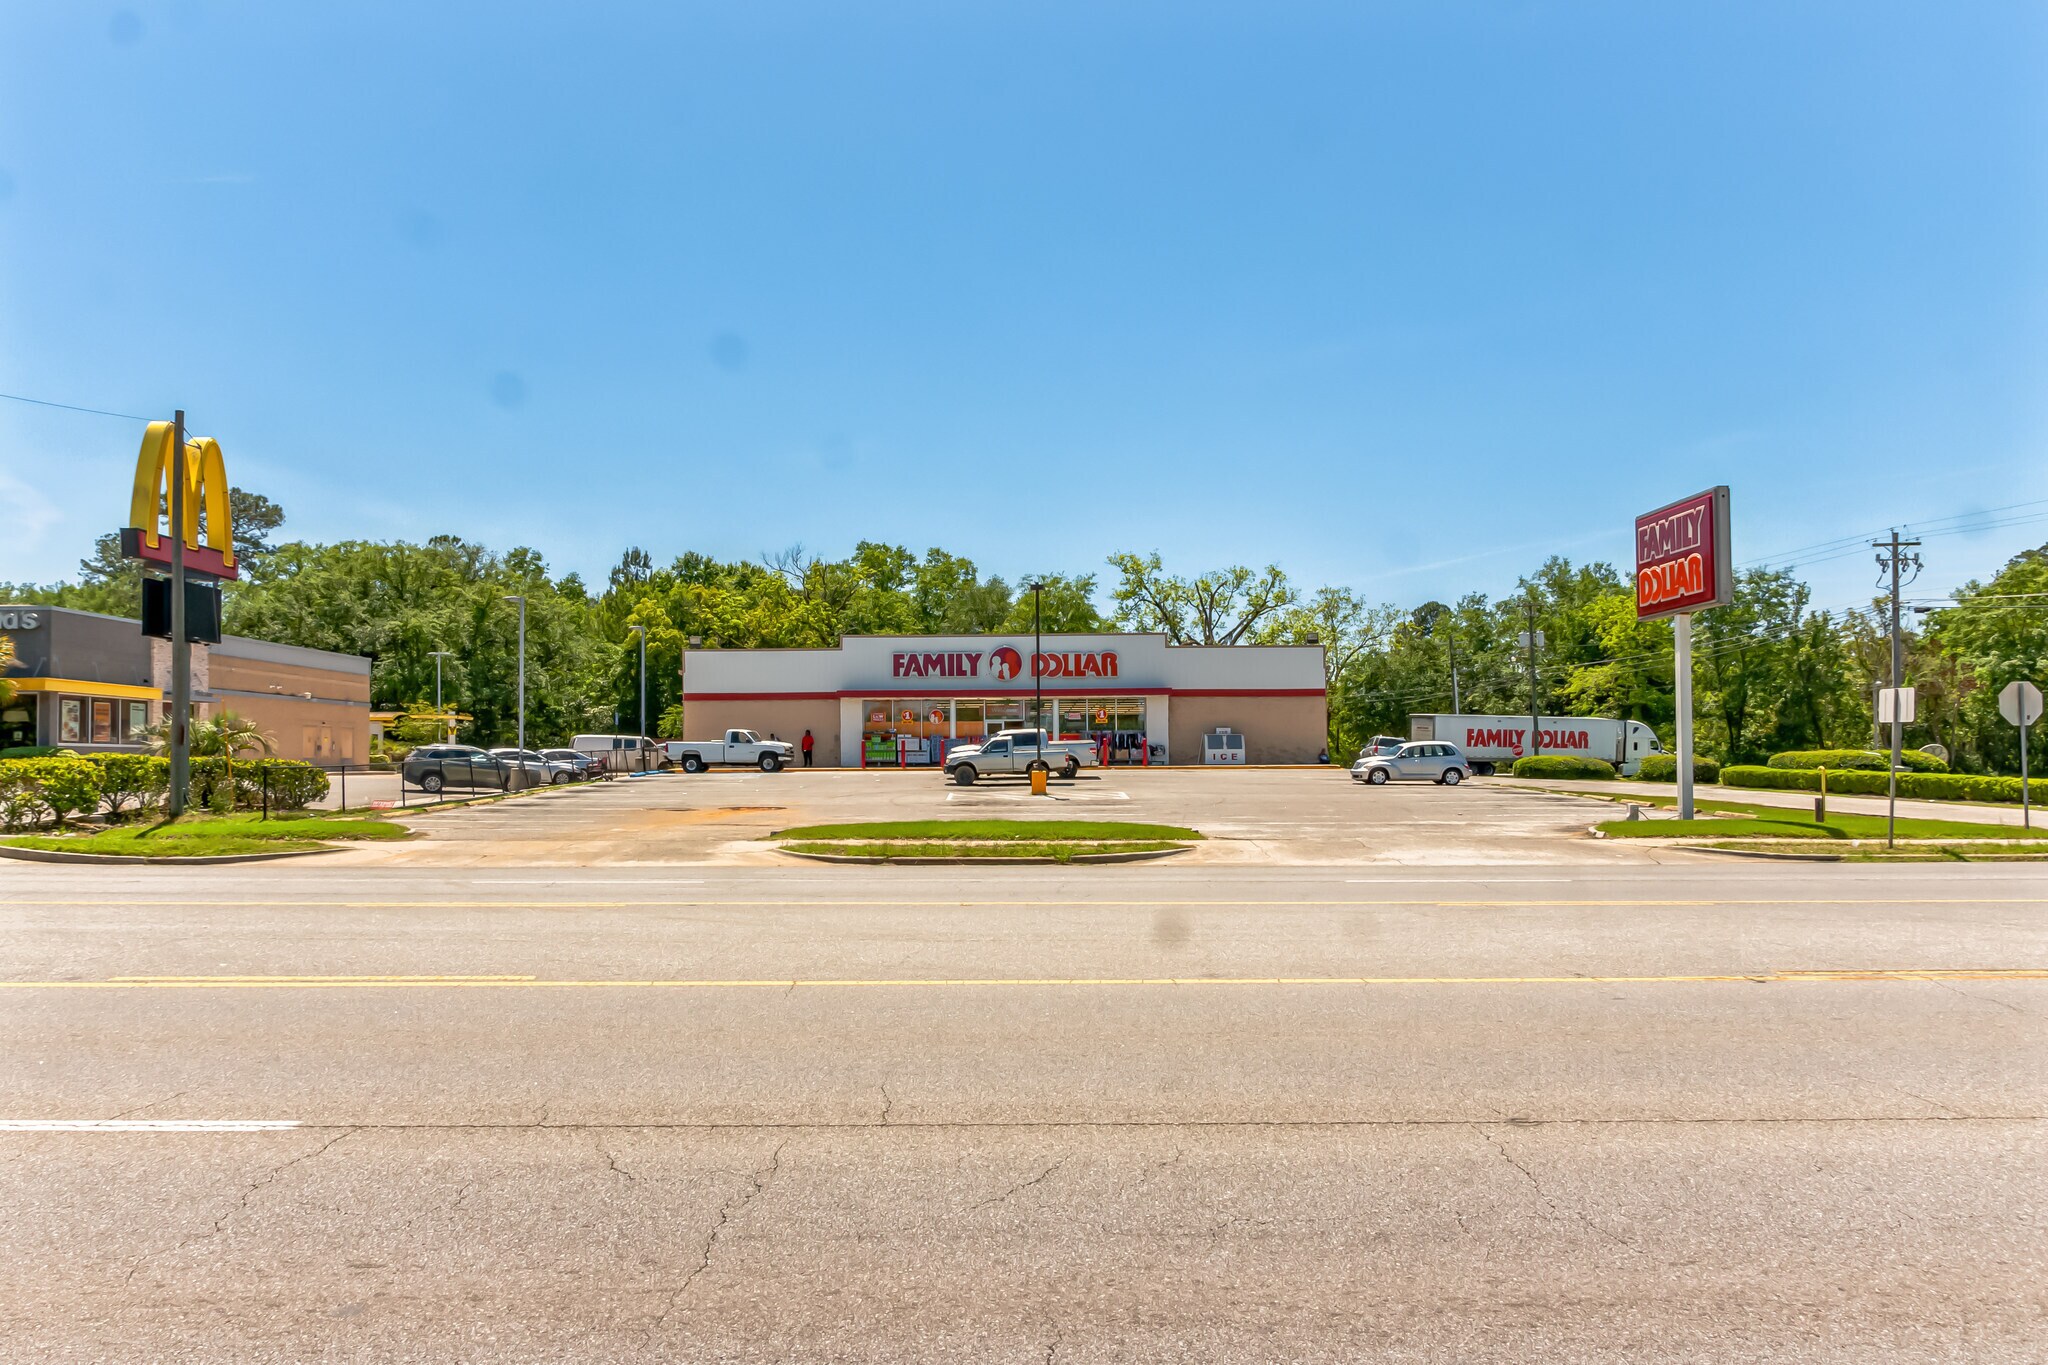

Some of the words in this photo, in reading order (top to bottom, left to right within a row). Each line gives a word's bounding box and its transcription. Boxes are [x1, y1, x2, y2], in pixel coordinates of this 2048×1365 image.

[1638, 505, 1705, 564] FAMILY
[1639, 553, 1704, 607] DOLLAR
[892, 652, 983, 678] FAMILY
[1030, 651, 1119, 678] DOLLAR
[1466, 728, 1526, 748] FAMILY
[1531, 729, 1589, 749] DOLLAR
[1212, 753, 1238, 761] ICE
